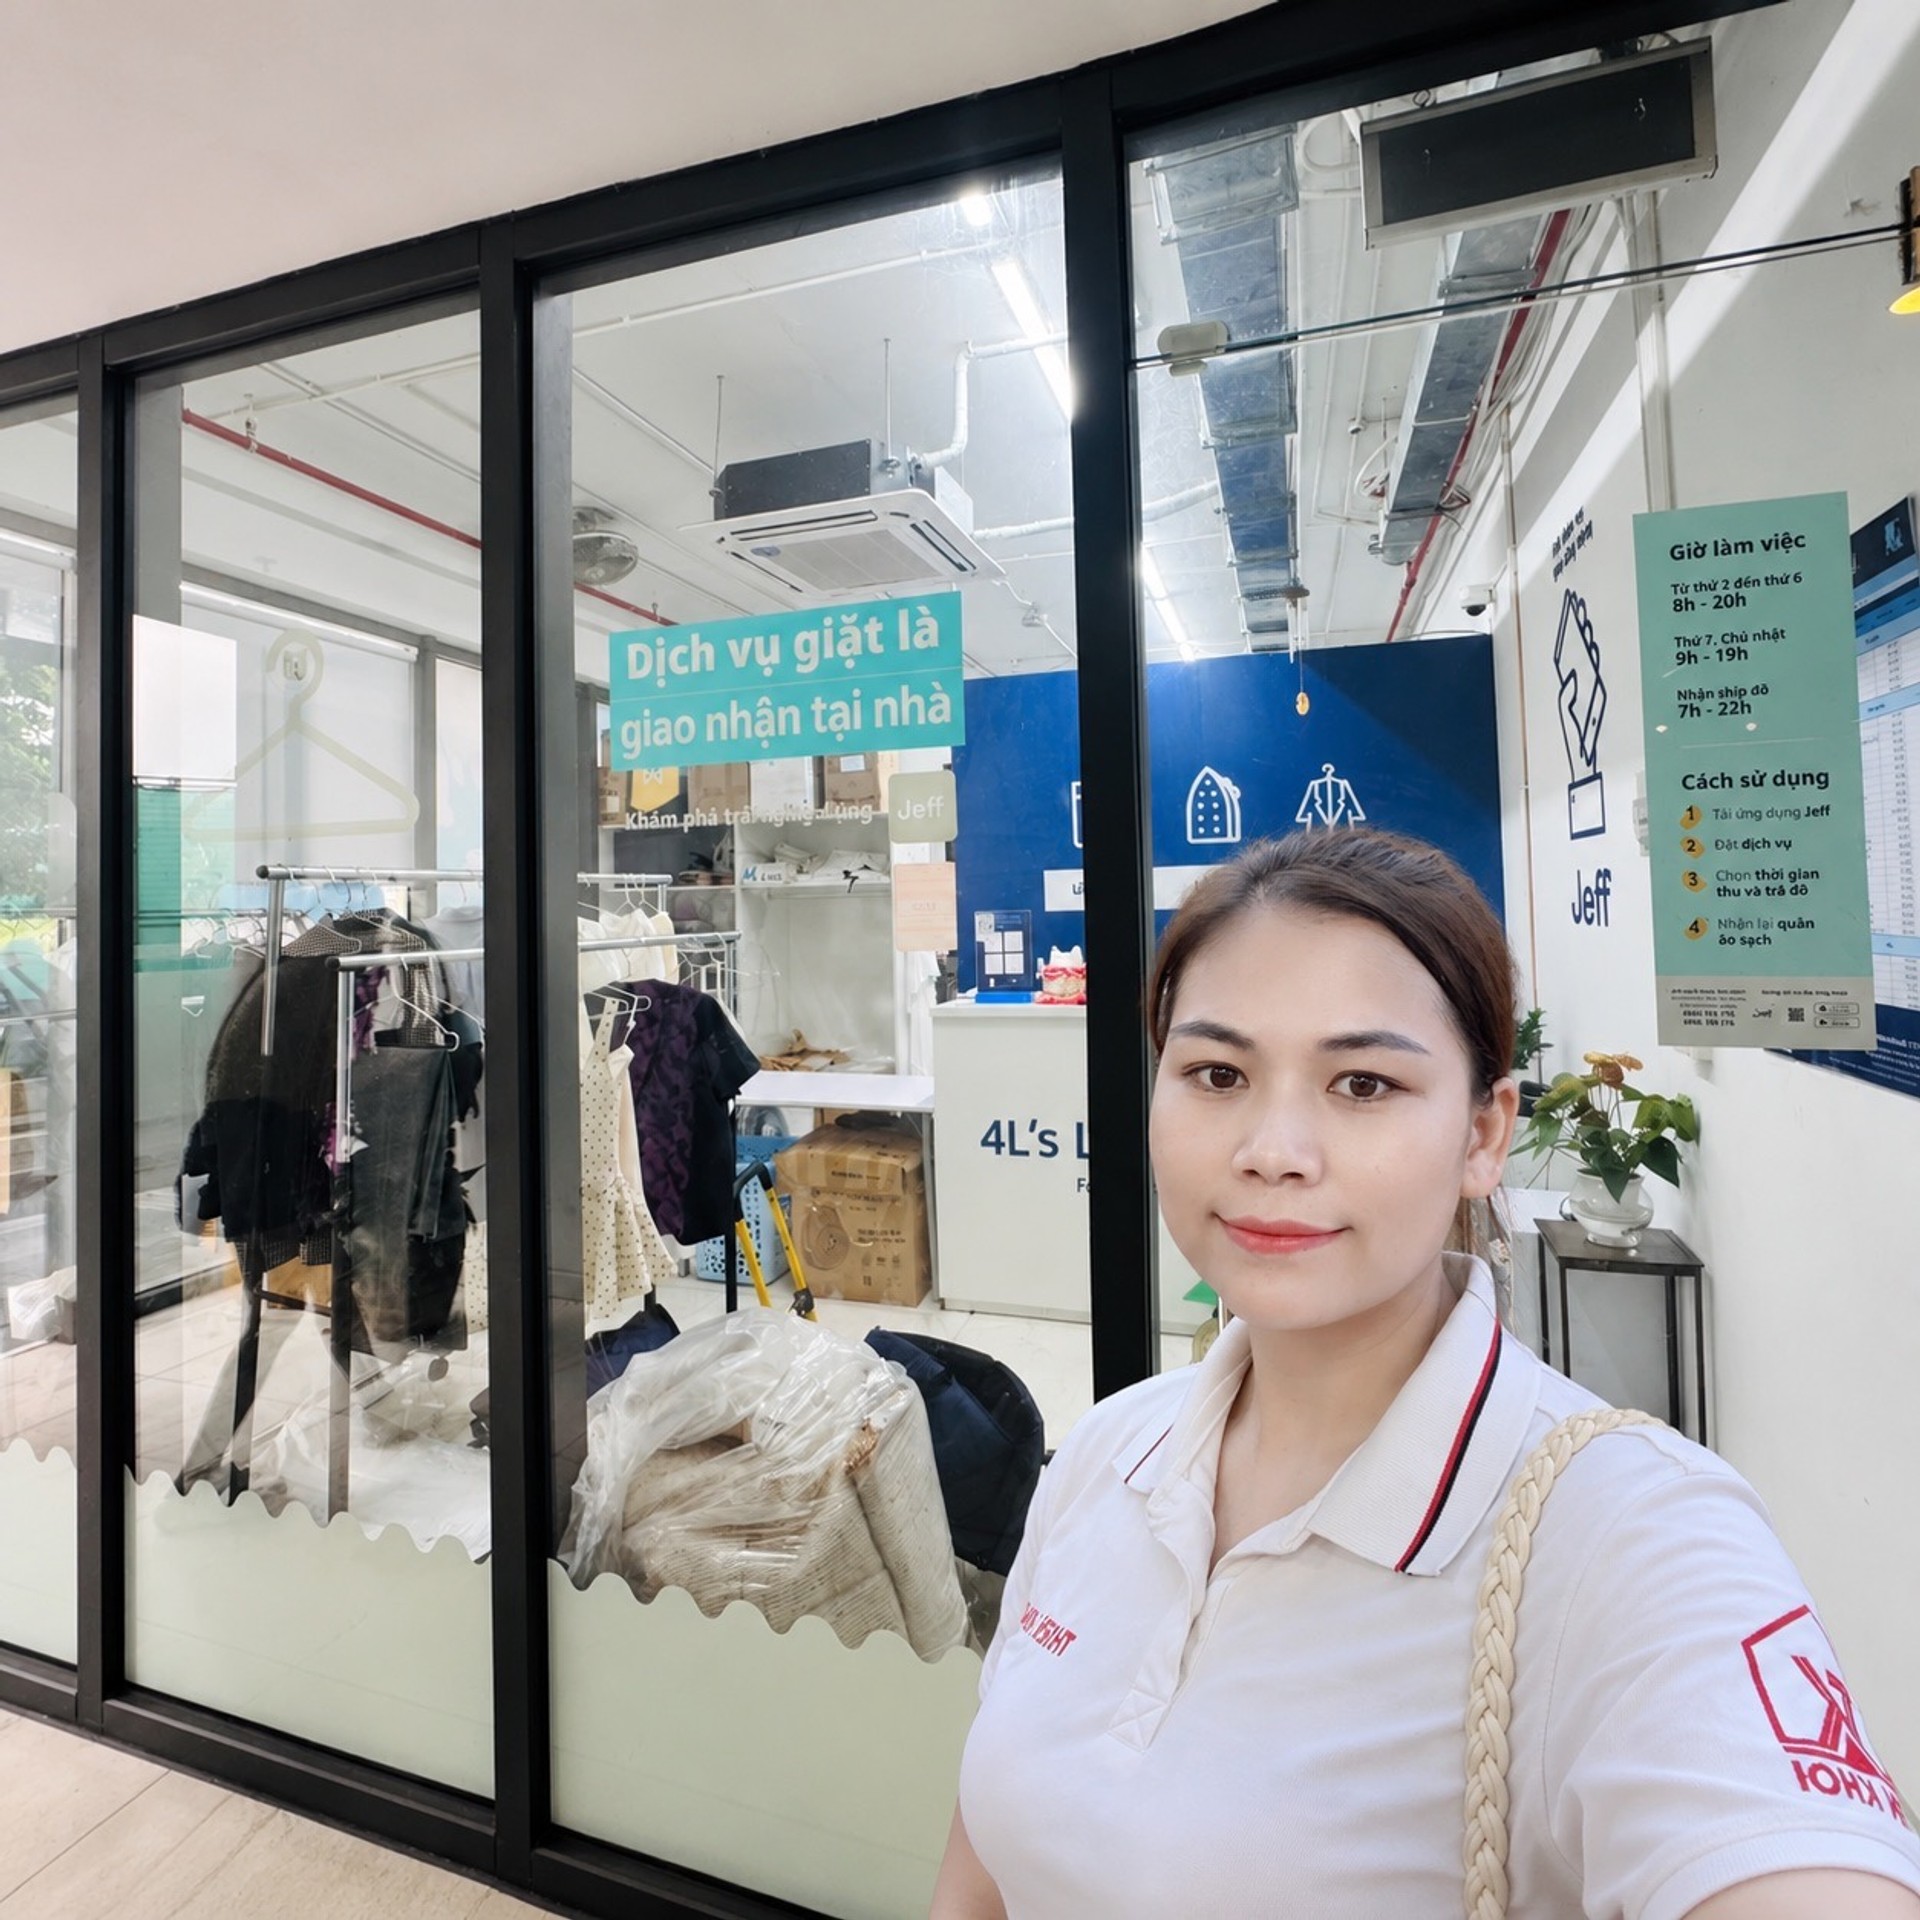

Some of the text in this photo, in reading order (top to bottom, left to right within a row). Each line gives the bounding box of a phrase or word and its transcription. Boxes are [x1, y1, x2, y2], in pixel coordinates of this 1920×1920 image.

[1669, 532, 1806, 561] Giờ làm việc
[1671, 583, 1691, 596] Từ
[1722, 579, 1730, 590] 2
[1733, 575, 1761, 589] đến
[1764, 573, 1790, 587] thứ
[1792, 572, 1803, 583] 6
[1672, 598, 1696, 613] 8h
[1712, 593, 1747, 611] 20h
[627, 605, 939, 688] Dịch vụ giặt là
[1674, 635, 1703, 648] Thứ
[1721, 631, 1748, 644] Chủ
[1753, 628, 1786, 643] nhật
[1675, 650, 1698, 666] 9h
[1716, 647, 1749, 663] 19h
[1718, 686, 1748, 700] ship
[1678, 703, 1701, 719] 7h
[1718, 700, 1752, 717] 22h
[621, 681, 951, 760] giao nhận tại nhà
[1681, 768, 1829, 791] Cách sử dụng
[897, 796, 944, 820] Jeff
[1686, 805, 1694, 821] 1
[1765, 806, 1801, 822] dụng
[1804, 804, 1831, 817] Jeff
[625, 807, 679, 831] Khám
[682, 804, 718, 833] phá
[1686, 839, 1696, 852] 2
[1741, 838, 1771, 852] dịch
[1775, 839, 1792, 852] vụ
[1688, 872, 1698, 886] 3
[1755, 867, 1784, 881] thời
[1788, 868, 1820, 883] gian
[1571, 868, 1612, 927] Jeff
[1716, 885, 1741, 898] thu
[1745, 885, 1761, 897] và
[1689, 920, 1699, 934] 4
[1740, 933, 1772, 948] sạch
